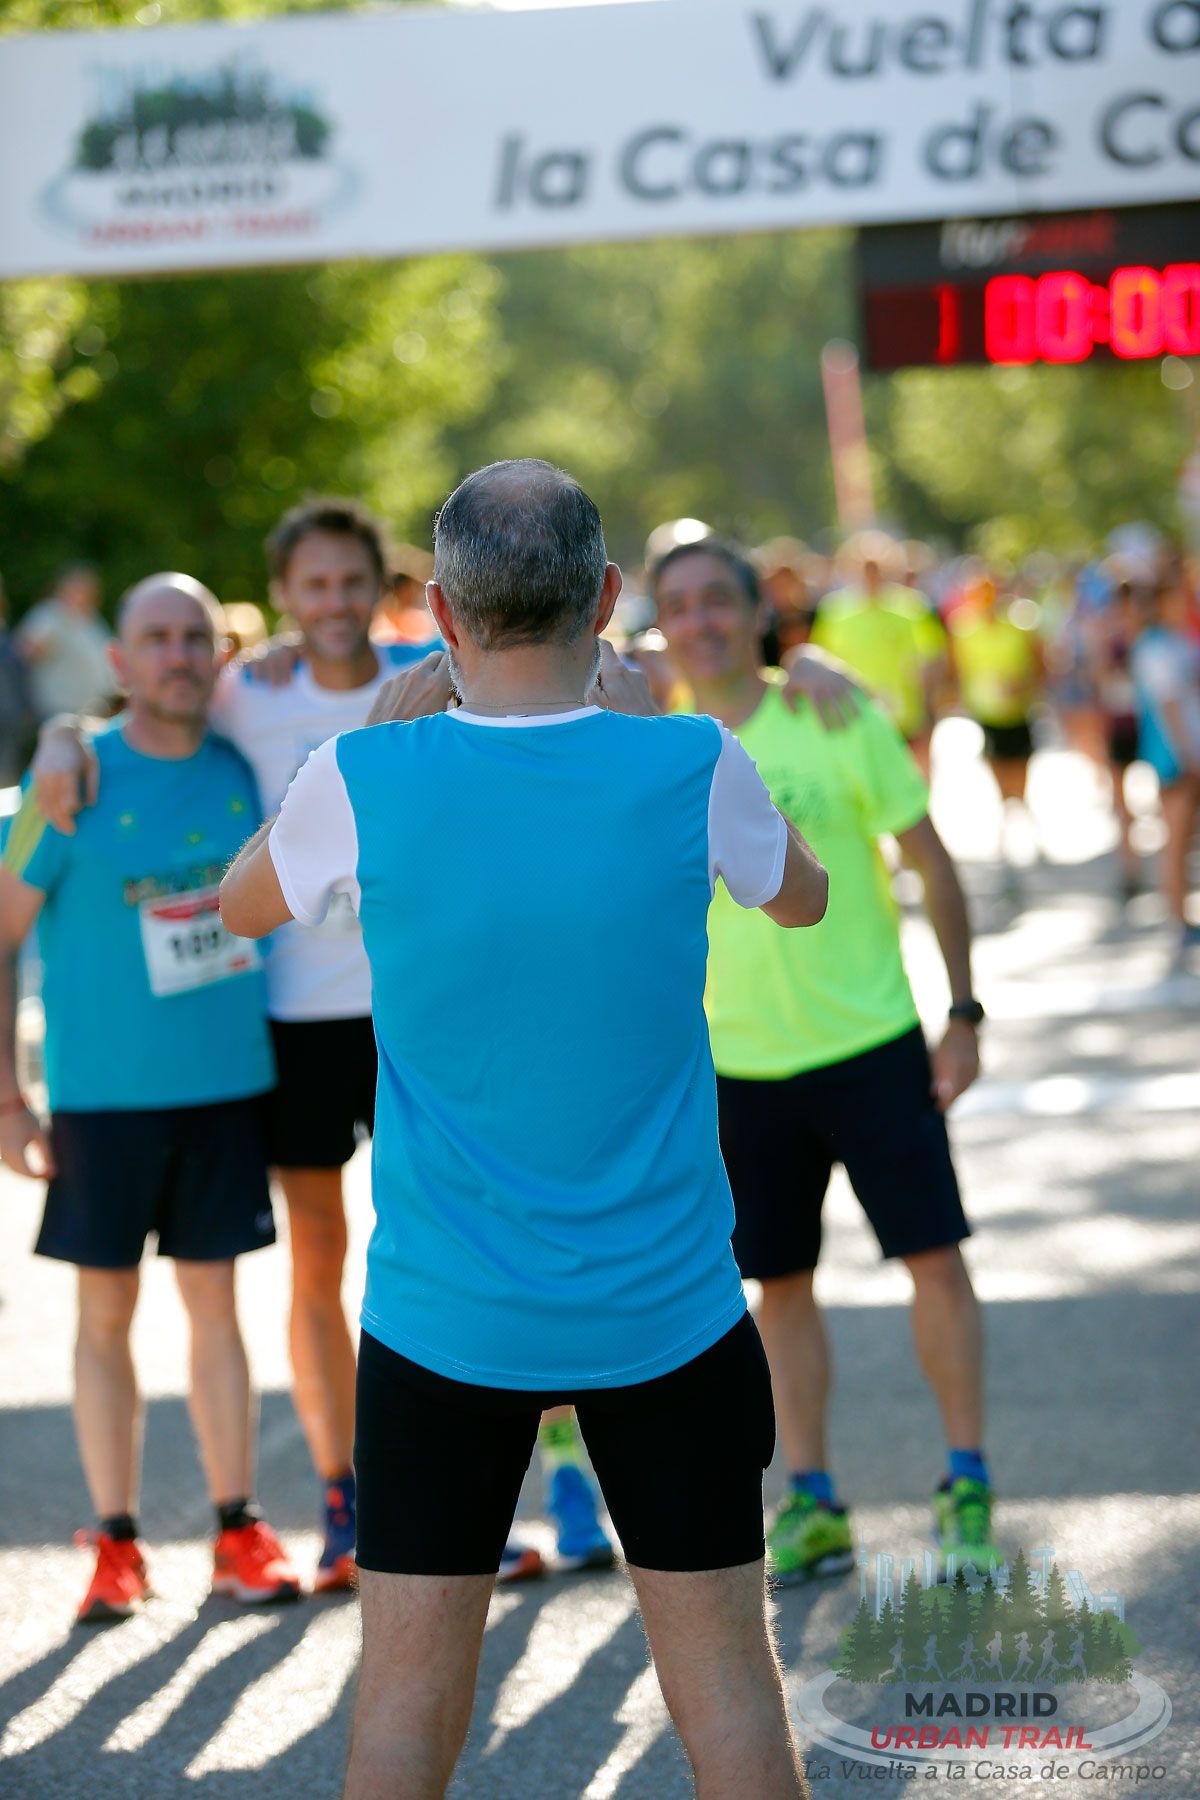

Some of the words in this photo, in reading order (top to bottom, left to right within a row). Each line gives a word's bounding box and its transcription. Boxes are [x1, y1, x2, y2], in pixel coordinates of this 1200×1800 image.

[750, 0, 1106, 82] Vuelta
[494, 134, 591, 212] la
[618, 123, 885, 200] Casa
[922, 100, 1058, 180] de
